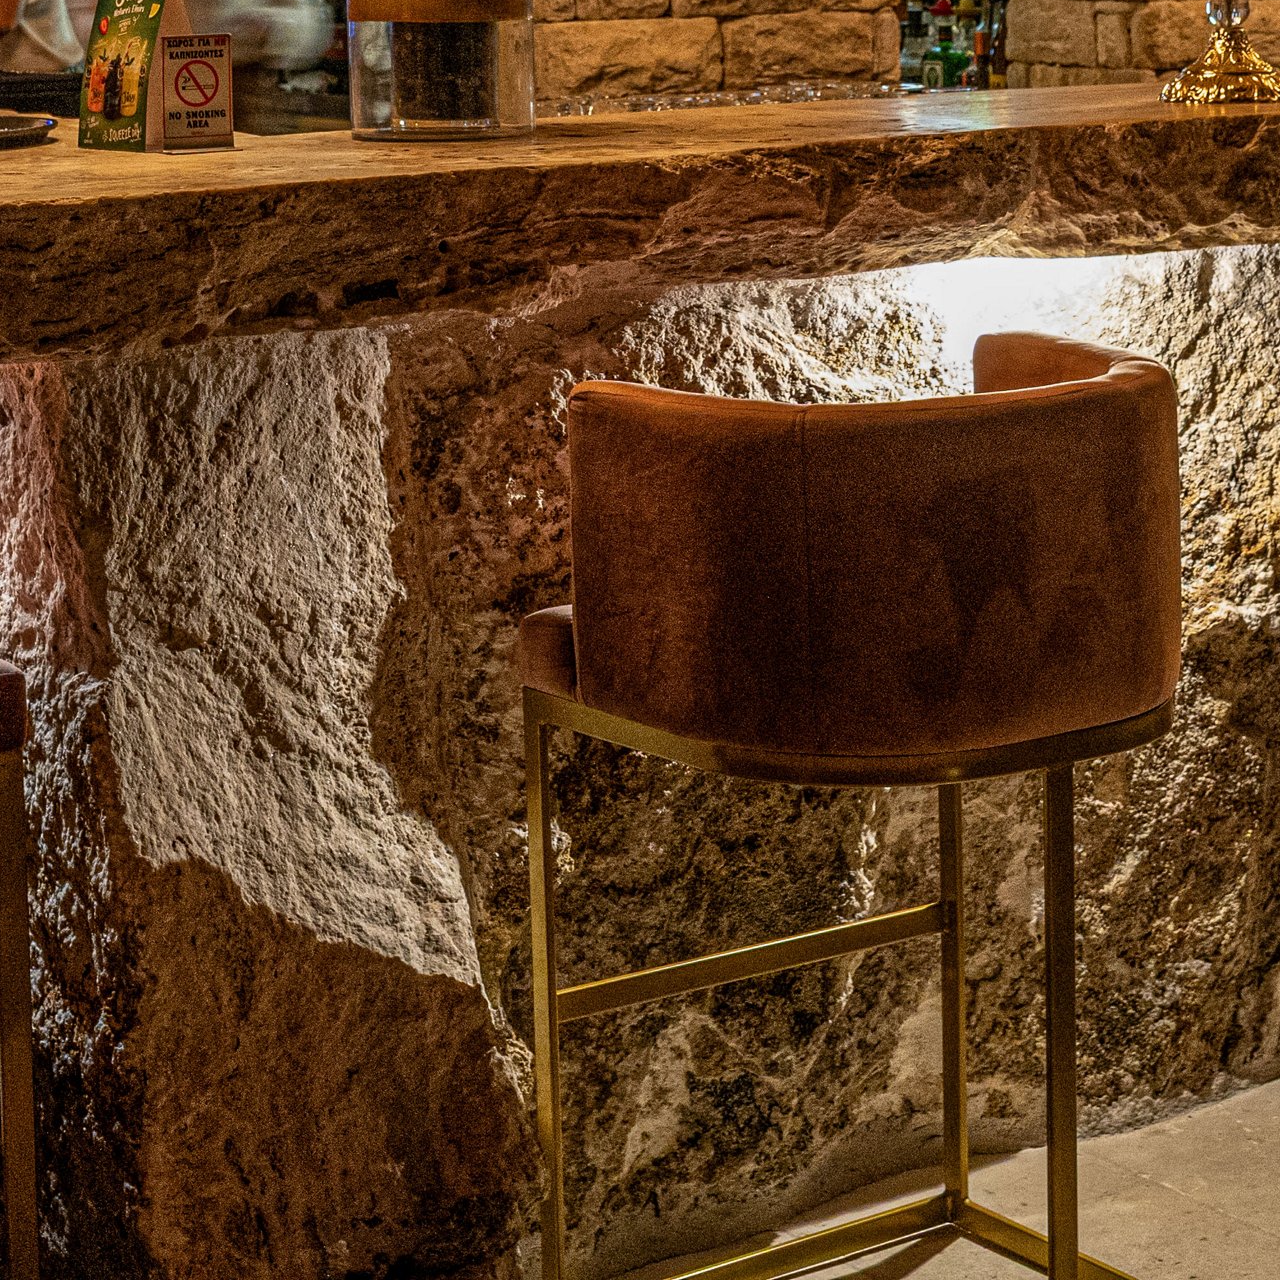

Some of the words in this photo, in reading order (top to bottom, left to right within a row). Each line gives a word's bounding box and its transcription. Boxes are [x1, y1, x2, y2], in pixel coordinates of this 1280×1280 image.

[198, 38, 210, 48] ΓΙΑ
[168, 111, 181, 121] NO
[185, 109, 226, 120] SMOKING
[187, 119, 209, 129] AREA
